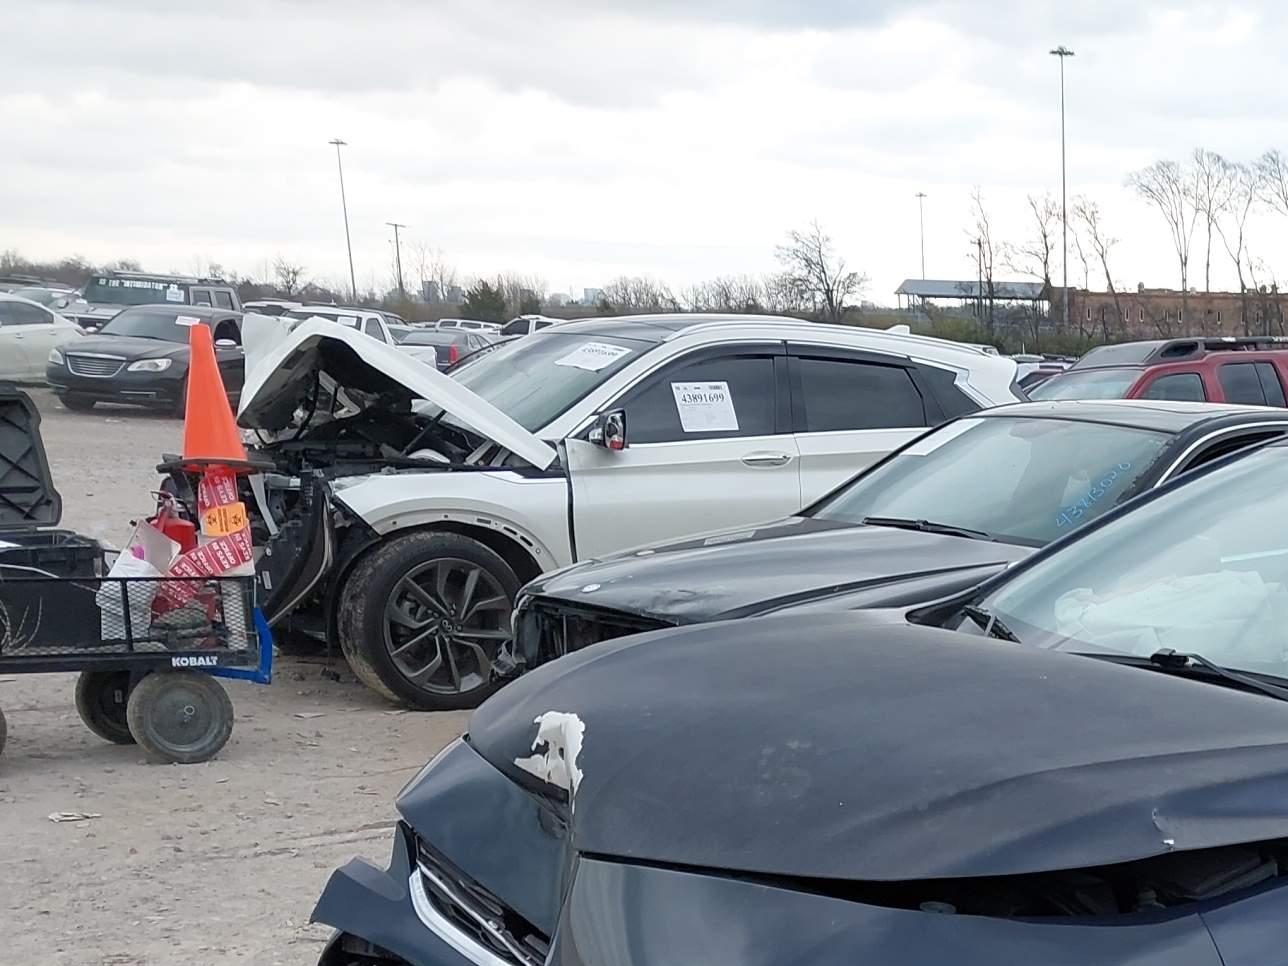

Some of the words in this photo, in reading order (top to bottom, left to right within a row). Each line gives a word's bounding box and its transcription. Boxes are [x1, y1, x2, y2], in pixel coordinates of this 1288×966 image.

[681, 393, 725, 403] 43891699
[216, 549, 230, 569] KEYS
[218, 540, 236, 565] OFFICE
[172, 656, 218, 667] KOBALT
